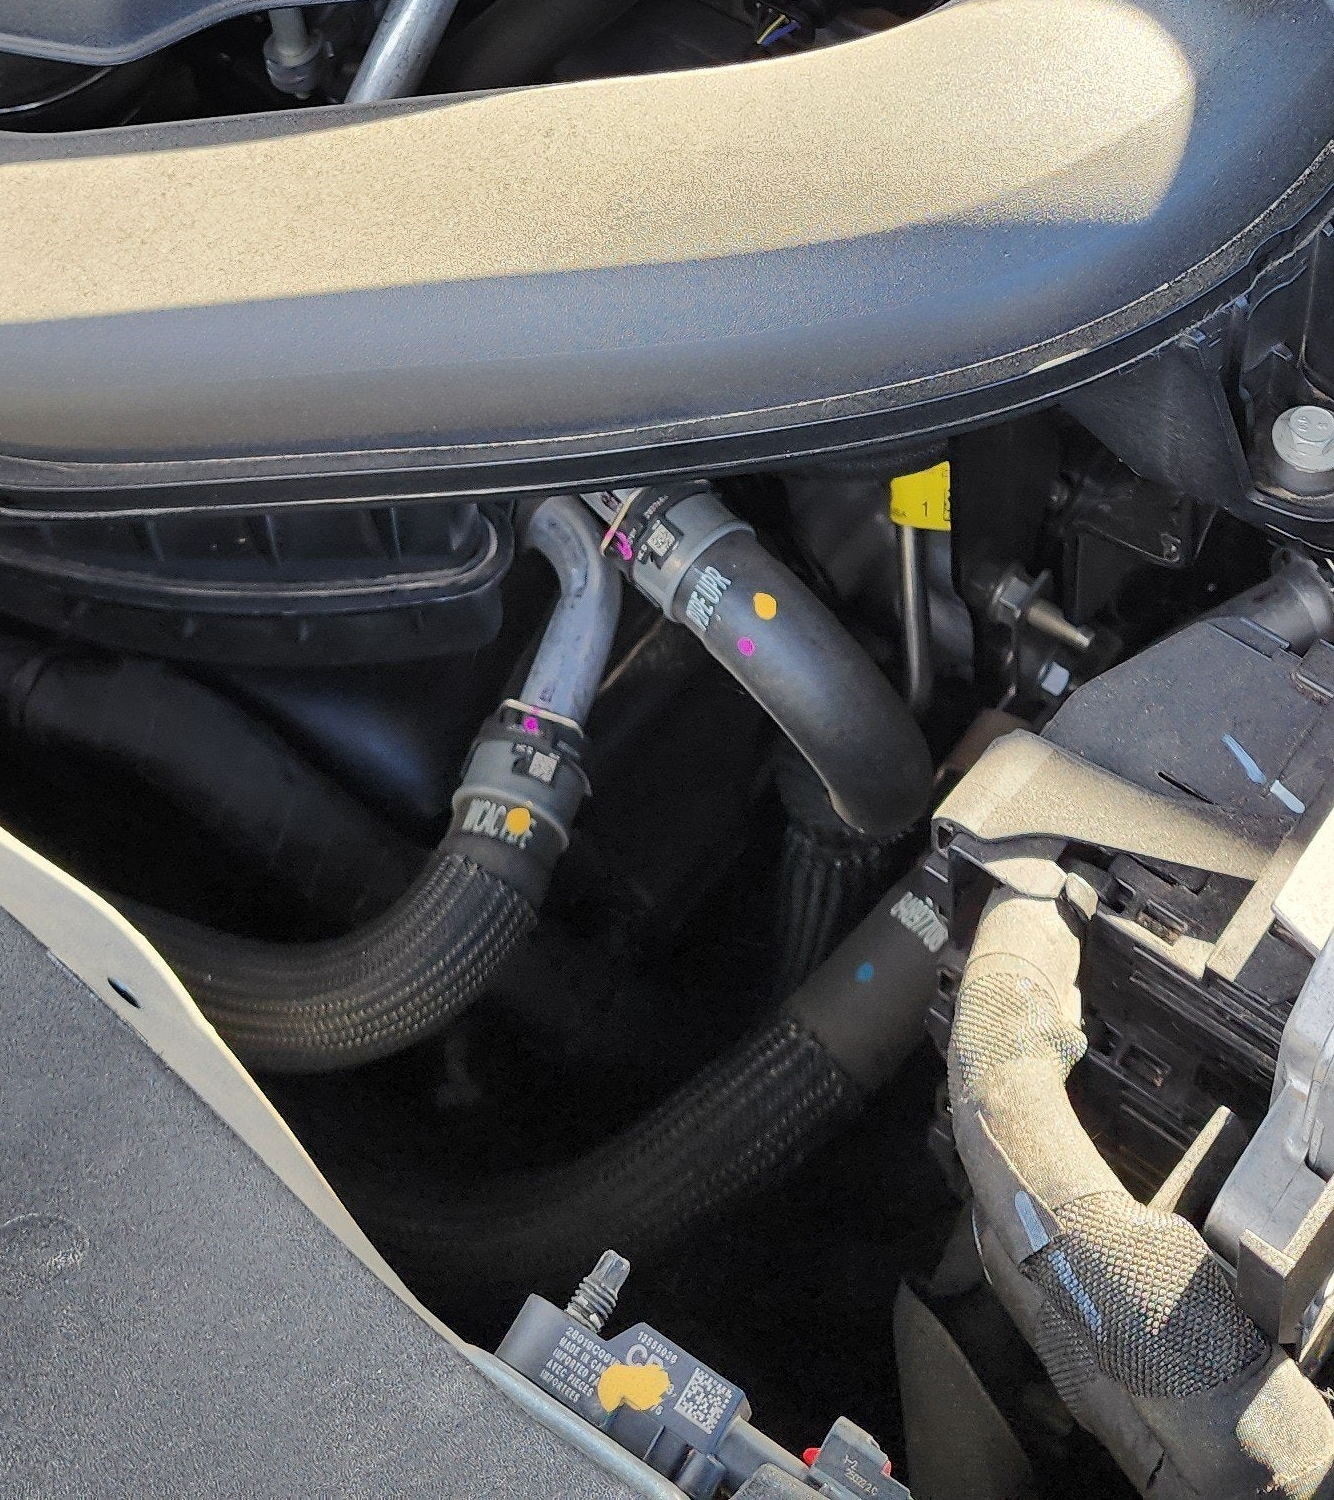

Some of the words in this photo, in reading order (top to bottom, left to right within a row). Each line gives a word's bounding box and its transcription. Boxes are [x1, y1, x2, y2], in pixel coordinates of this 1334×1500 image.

[923, 502, 927, 517] 1
[694, 567, 732, 604] UPR
[685, 592, 719, 629] PIPE
[553, 1349, 588, 1376] IMPORTED
[559, 1337, 581, 1356] MADE
[580, 1352, 590, 1363] IN
[546, 1359, 567, 1377] AVEC
